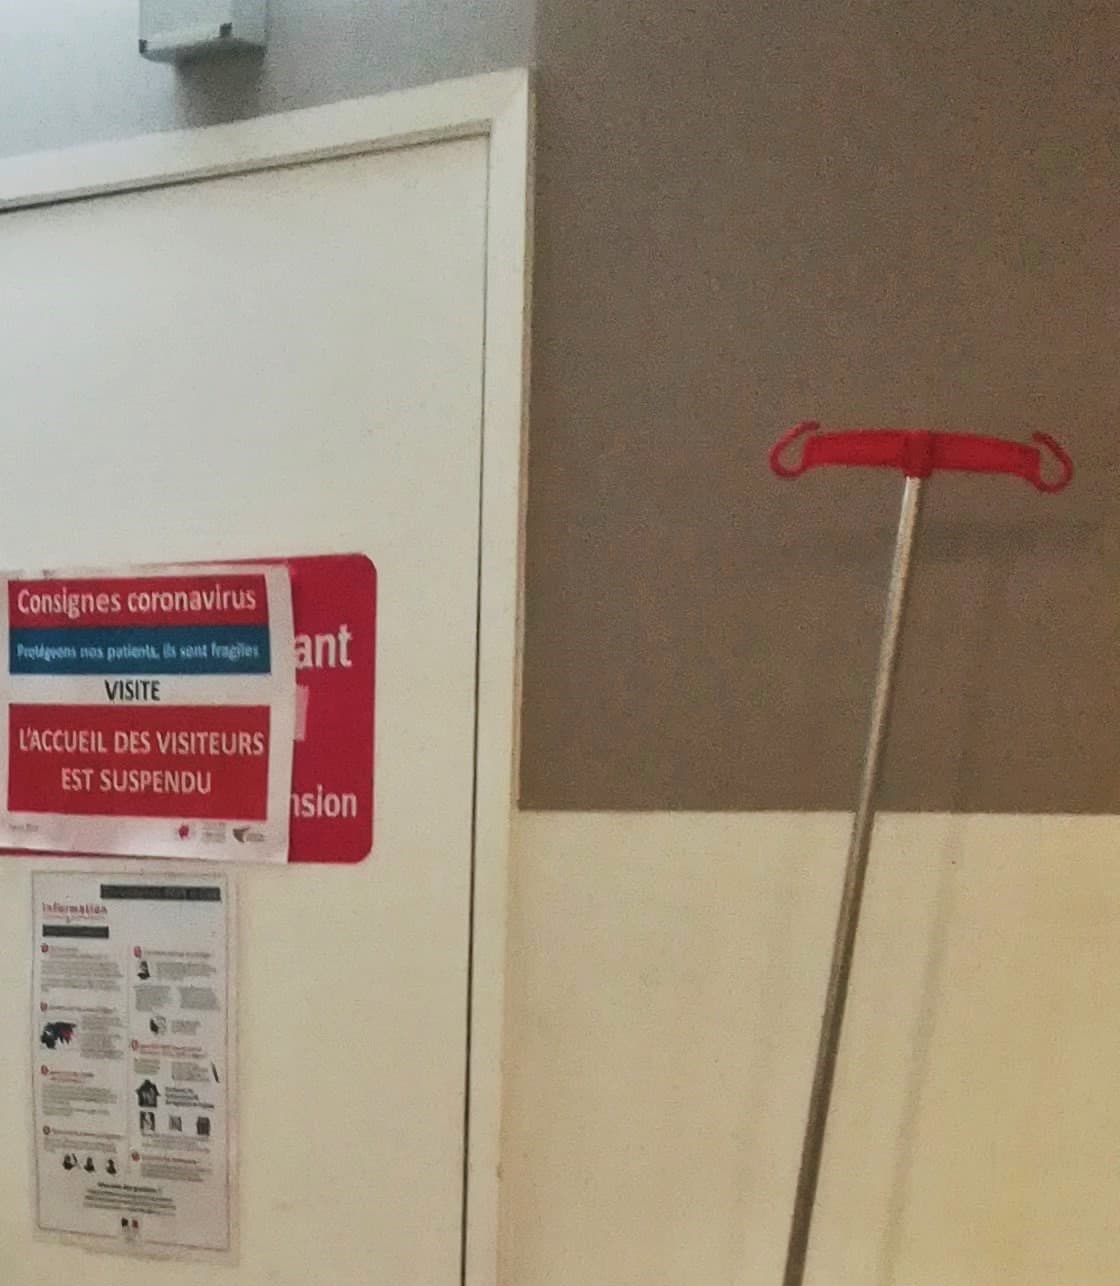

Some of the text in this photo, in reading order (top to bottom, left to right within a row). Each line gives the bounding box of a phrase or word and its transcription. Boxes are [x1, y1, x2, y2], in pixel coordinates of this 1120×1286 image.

[17, 584, 257, 619] Consignes coronavirus
[17, 642, 77, 662] Protégeons
[80, 646, 103, 659] nos
[163, 642, 176, 659] ils
[179, 643, 207, 659] sont
[211, 641, 259, 662] fragiles
[104, 680, 161, 702] VISITE
[20, 727, 265, 757] L'ACCUEIL DES VISITEURS
[62, 767, 212, 795] EST SUSPENDU
[41, 901, 108, 914] Information
